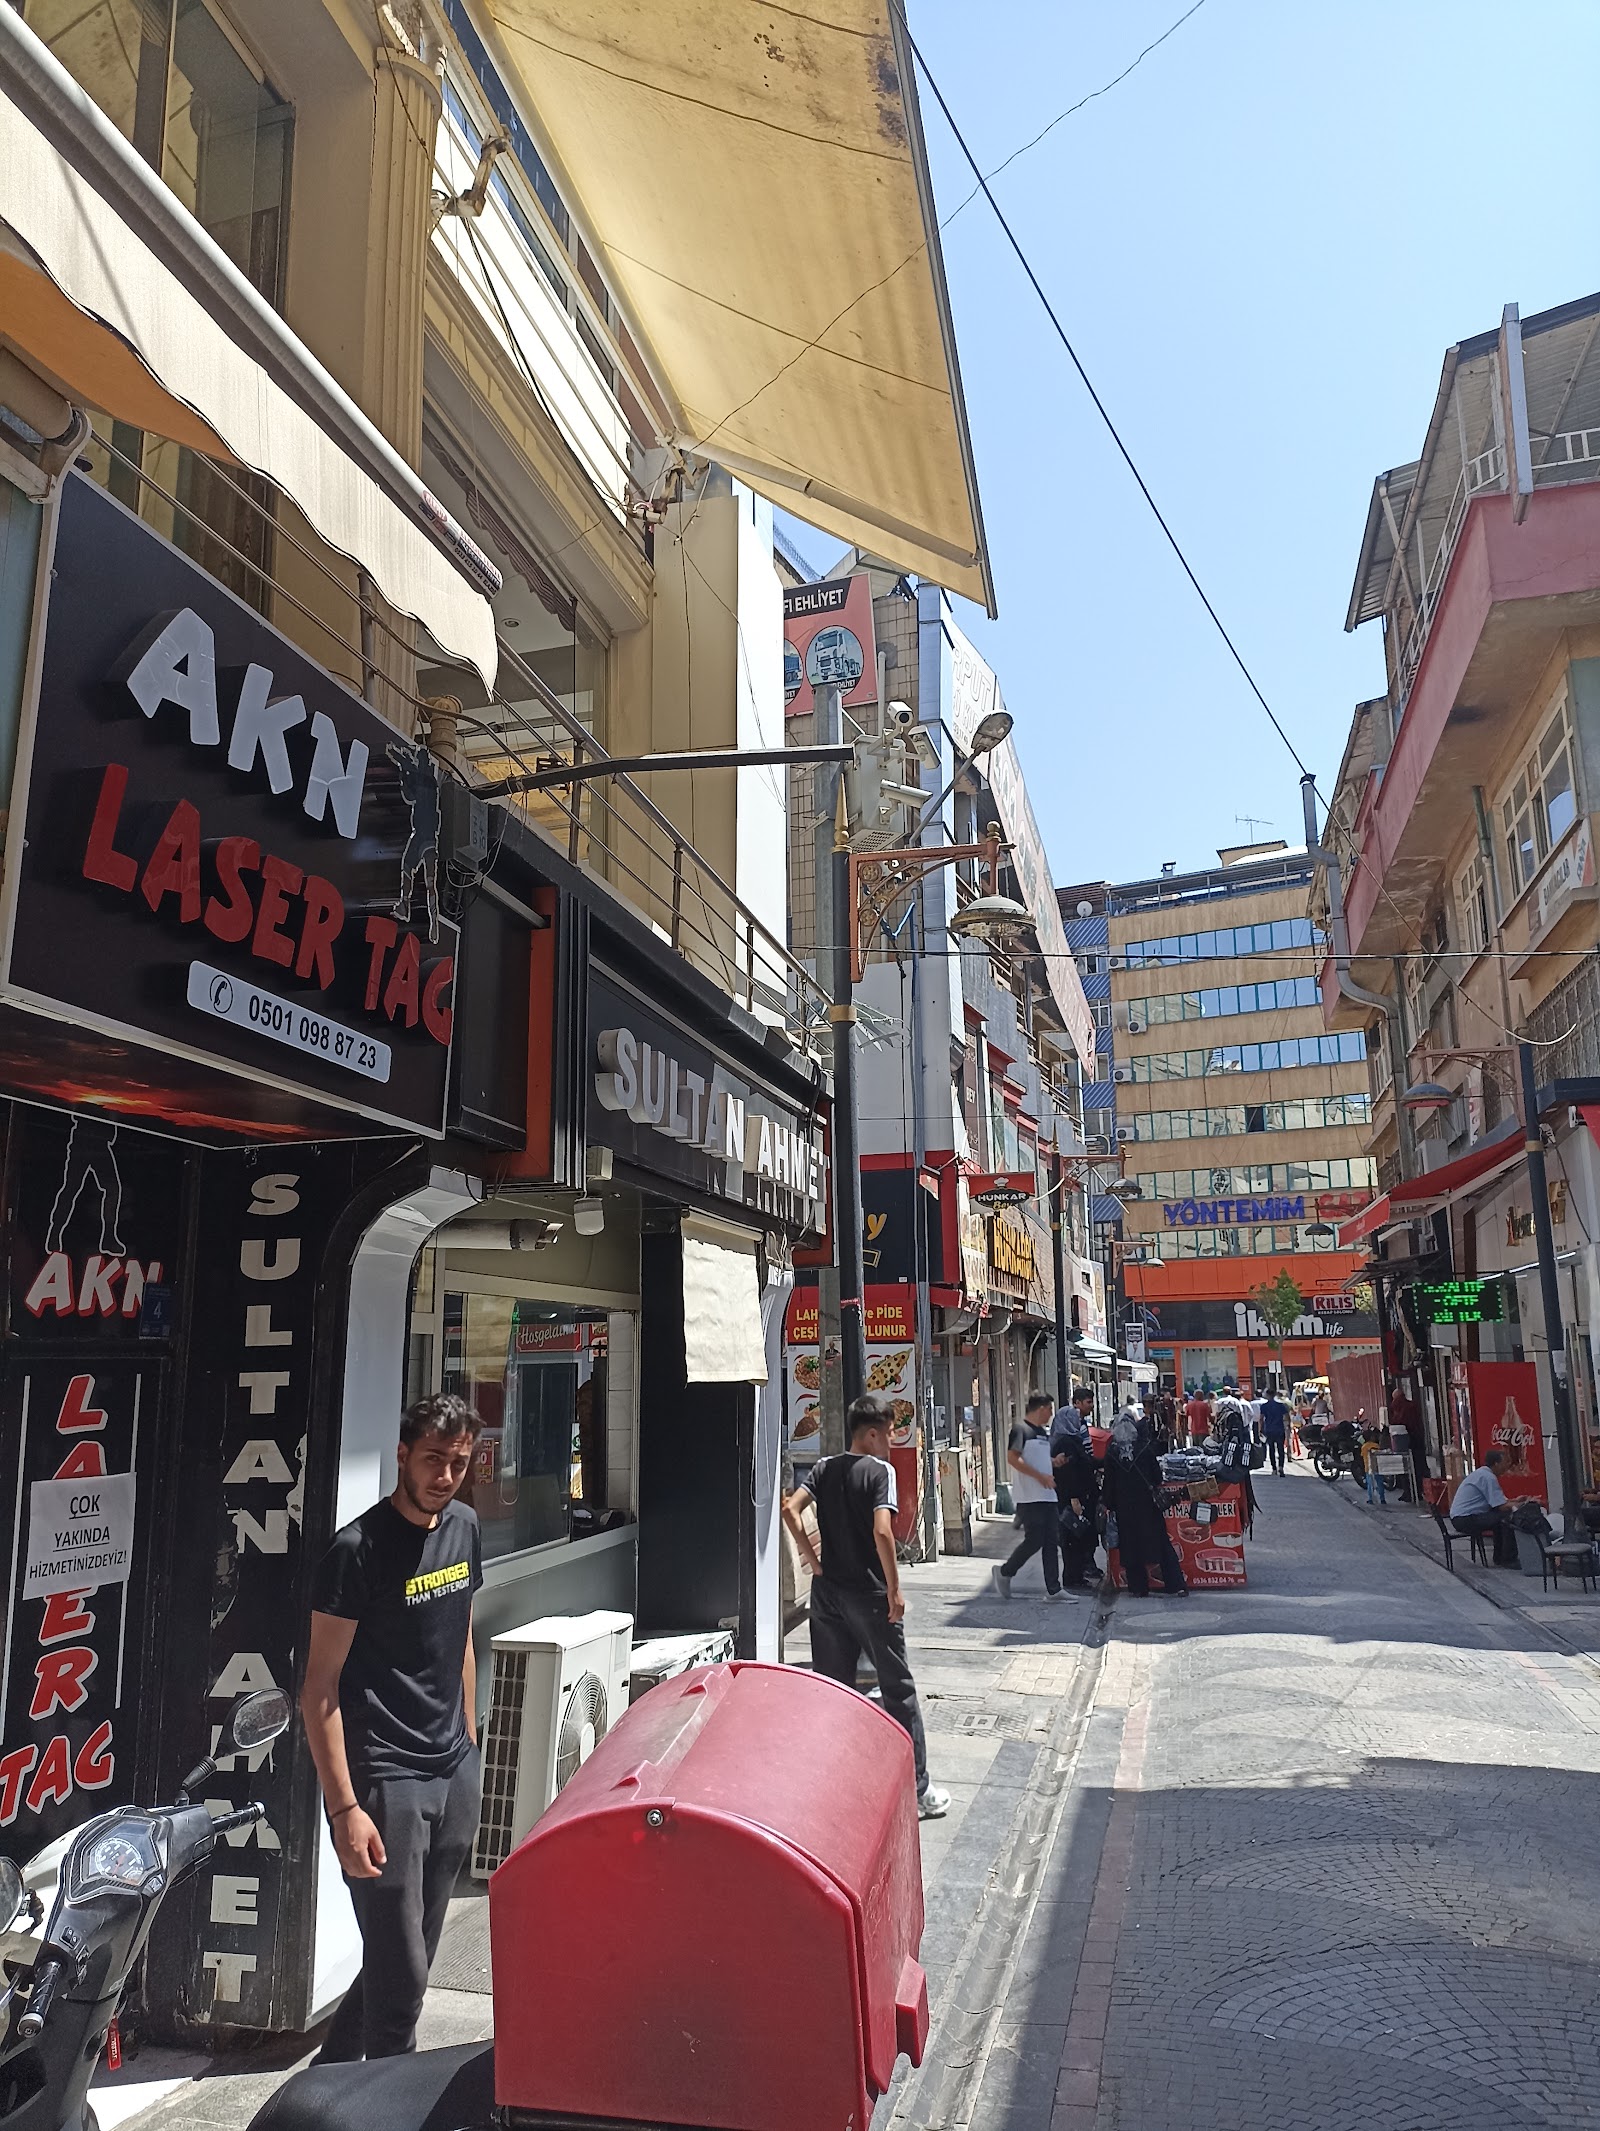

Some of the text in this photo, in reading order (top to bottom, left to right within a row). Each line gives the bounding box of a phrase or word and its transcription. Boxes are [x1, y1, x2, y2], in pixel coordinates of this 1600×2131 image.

[795, 587, 843, 612] EHLİYET
[127, 607, 369, 839] AKN
[82, 762, 345, 990] LASER
[249, 994, 377, 1069] 0501 098 87 23
[595, 1027, 743, 1163] SULTAN
[25, 1250, 163, 1318] AKN
[154, 1301, 162, 1319] 4
[876, 1304, 903, 1319] PİDE
[1325, 1322, 1344, 1337] life
[222, 1173, 302, 1554] SULTAN
[69, 1494, 101, 1519] ÇOK
[53, 1526, 111, 1548] YAKINDA
[29, 1549, 128, 1580] HİZMETİNİZDEYİZ!
[405, 1561, 470, 1596] STRONGER
[405, 1590, 431, 1607] THAN
[0, 1719, 115, 1828] TAG
